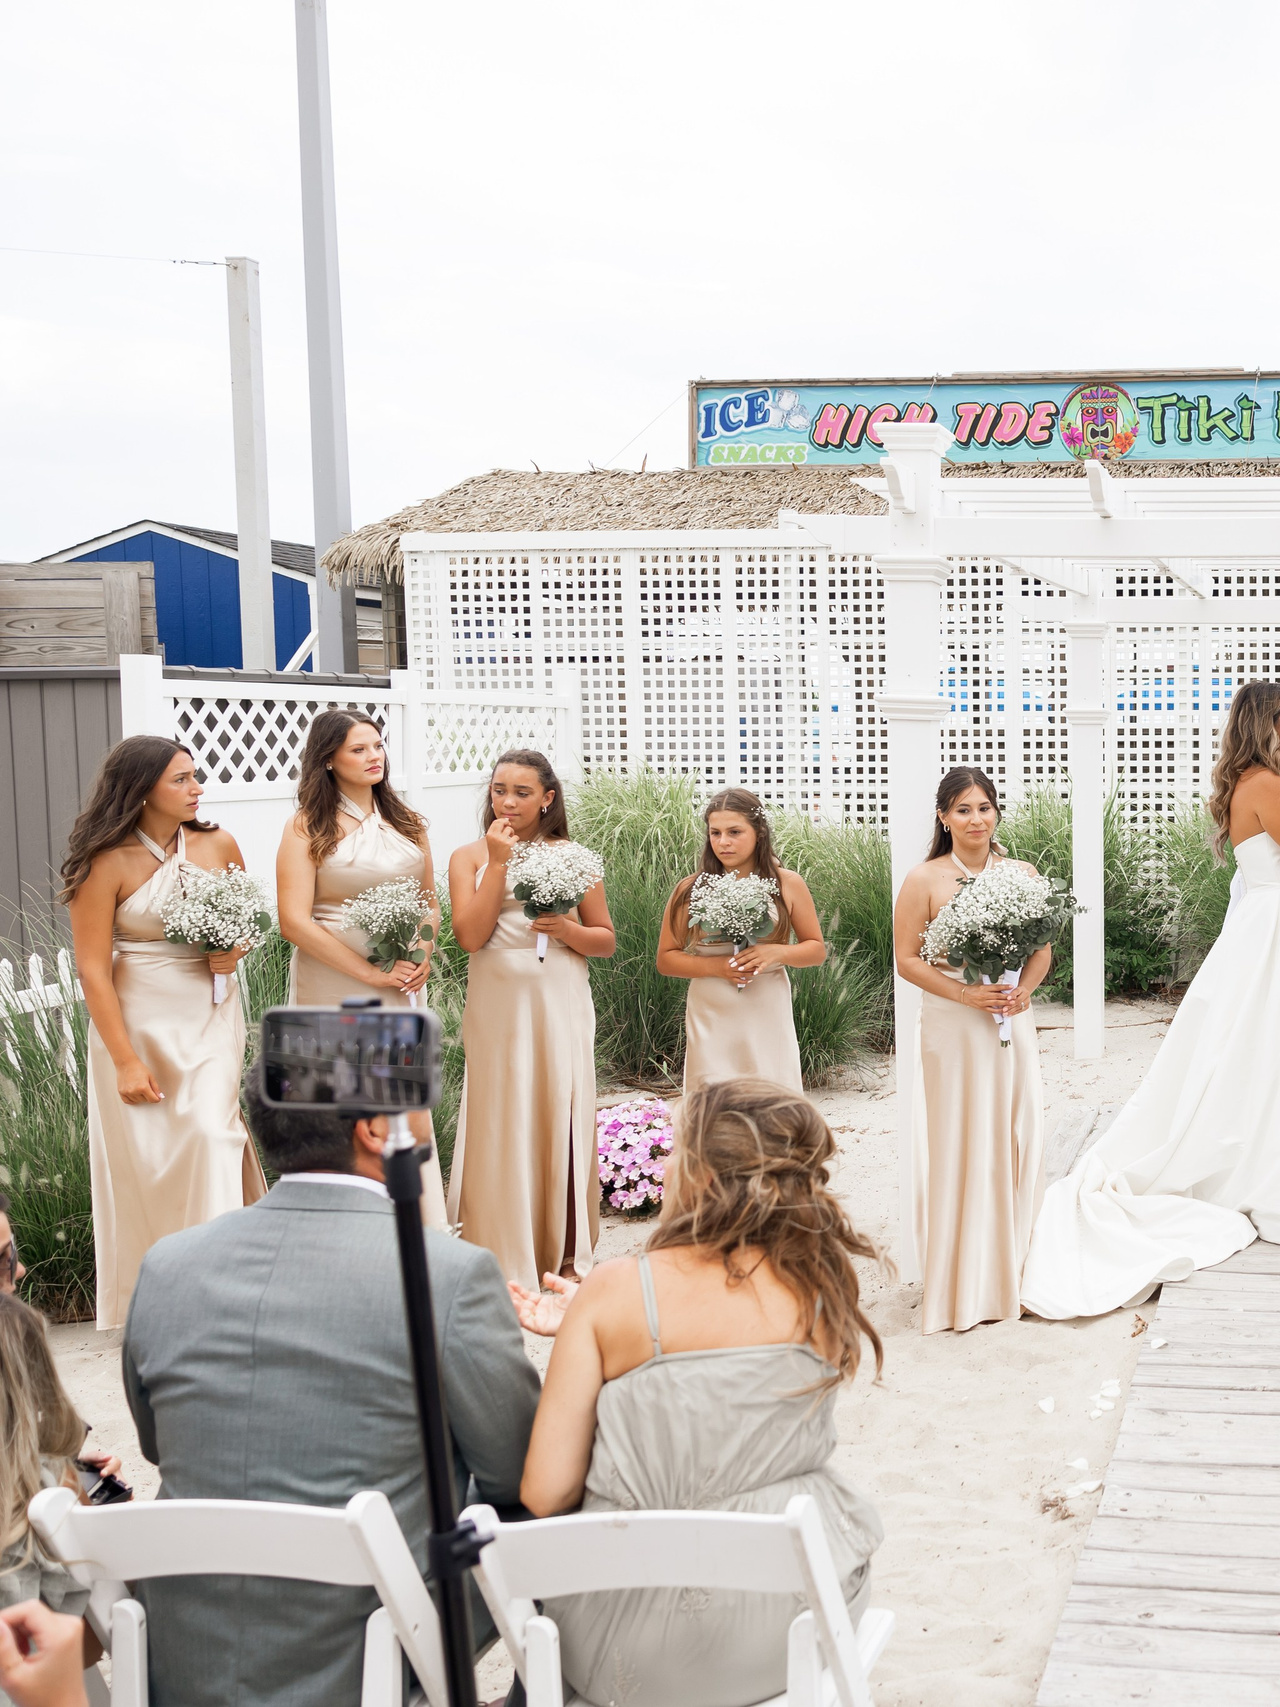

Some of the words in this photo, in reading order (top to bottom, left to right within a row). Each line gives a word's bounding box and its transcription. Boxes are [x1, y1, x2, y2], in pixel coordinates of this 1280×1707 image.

[701, 389, 771, 439] ICE
[954, 401, 1060, 447] TIDE
[1136, 393, 1262, 445] Tiki
[710, 444, 808, 463] SNACKS
